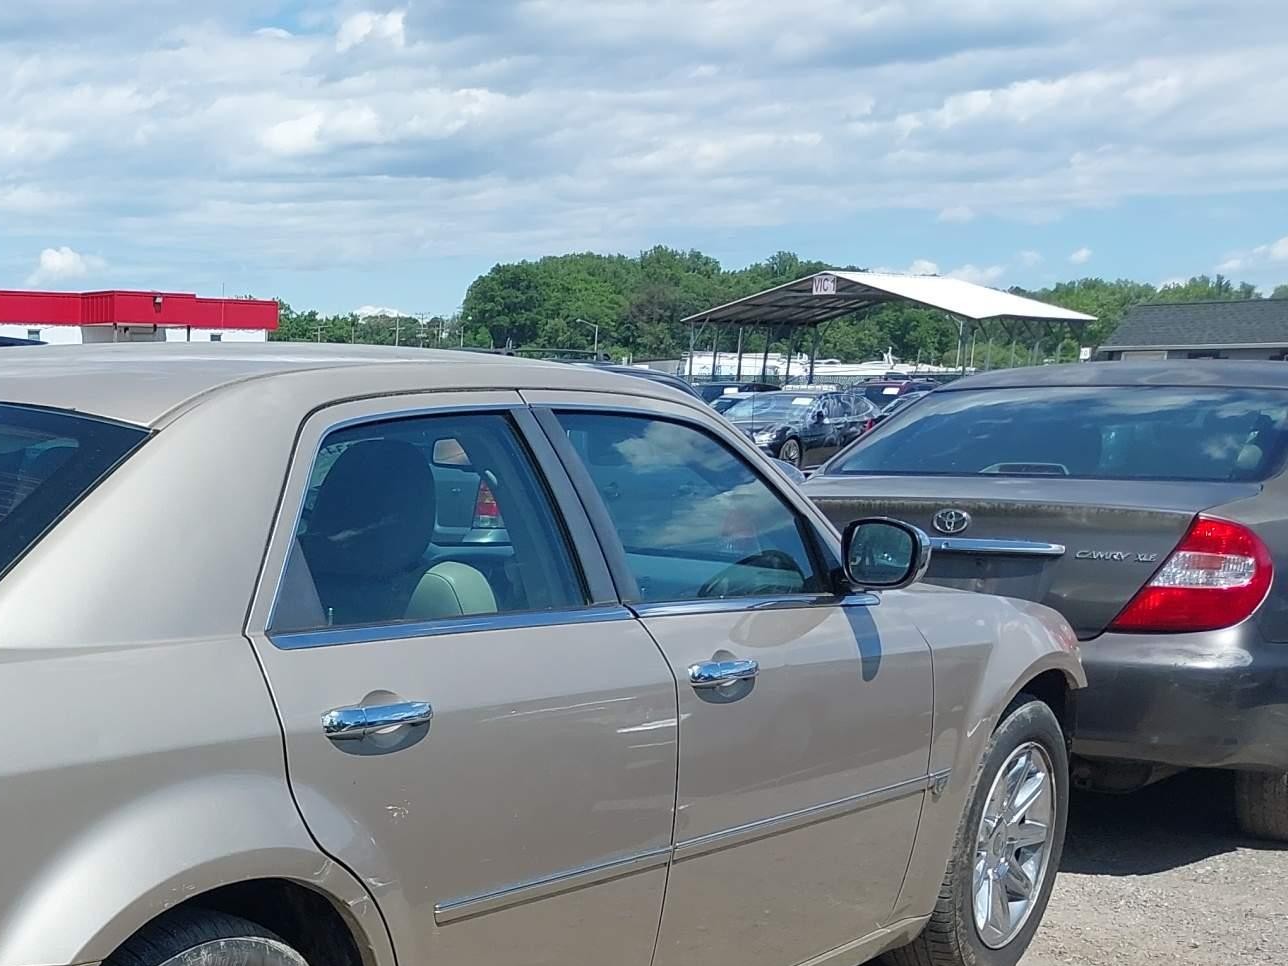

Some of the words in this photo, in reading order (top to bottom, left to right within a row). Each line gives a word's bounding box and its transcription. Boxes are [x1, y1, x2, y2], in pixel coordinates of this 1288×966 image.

[814, 277, 829, 292] VIC
[1075, 550, 1130, 561] CAMRY
[1135, 553, 1158, 562] XLE
